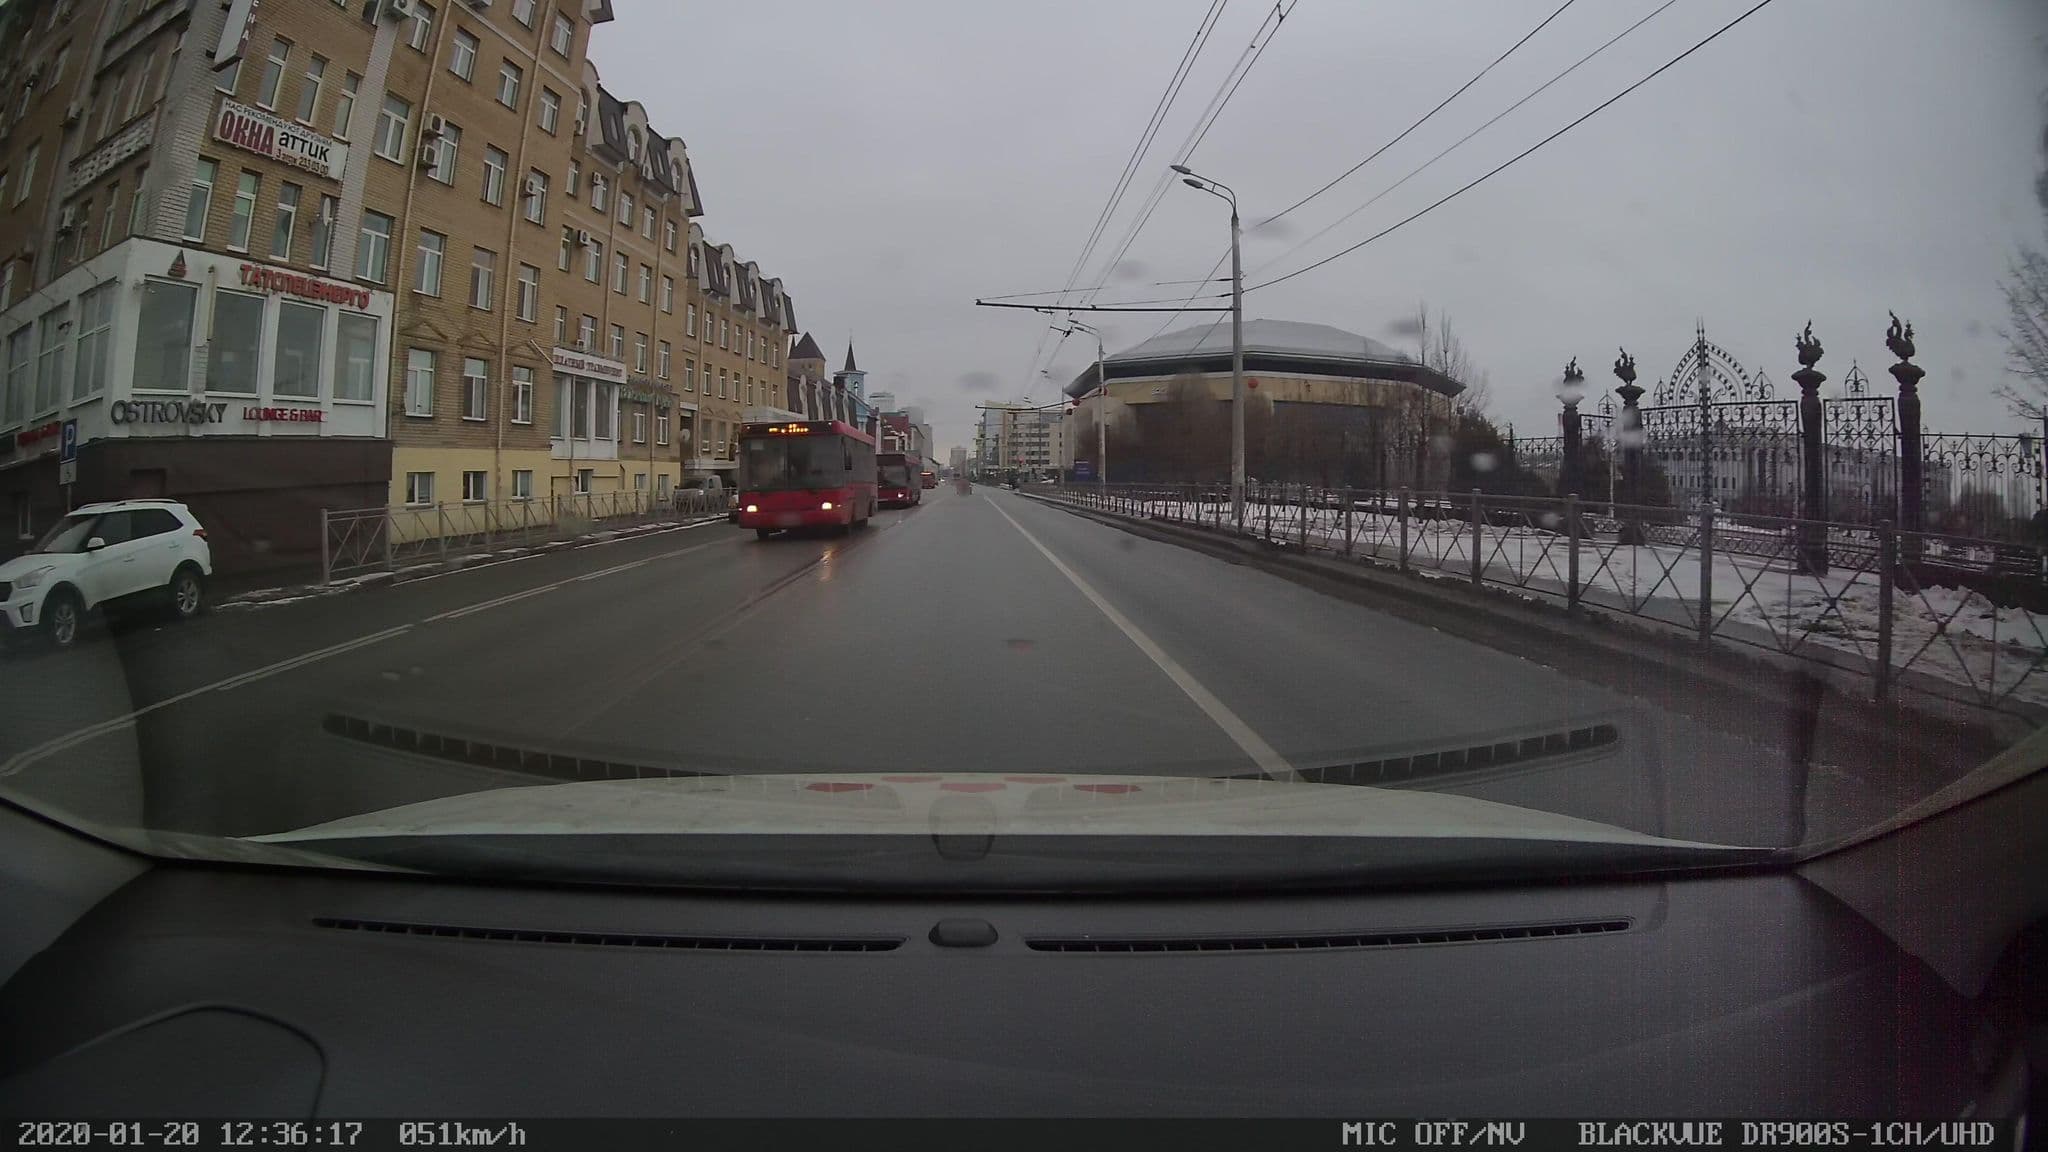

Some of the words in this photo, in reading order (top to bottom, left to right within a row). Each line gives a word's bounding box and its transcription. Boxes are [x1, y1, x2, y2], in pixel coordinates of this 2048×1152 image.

[220, 110, 275, 154] ОКНА
[240, 264, 370, 310] ТАТСПЕЦЭНЕРГО
[110, 399, 228, 426] OSTROVSKY
[64, 423, 75, 457] P
